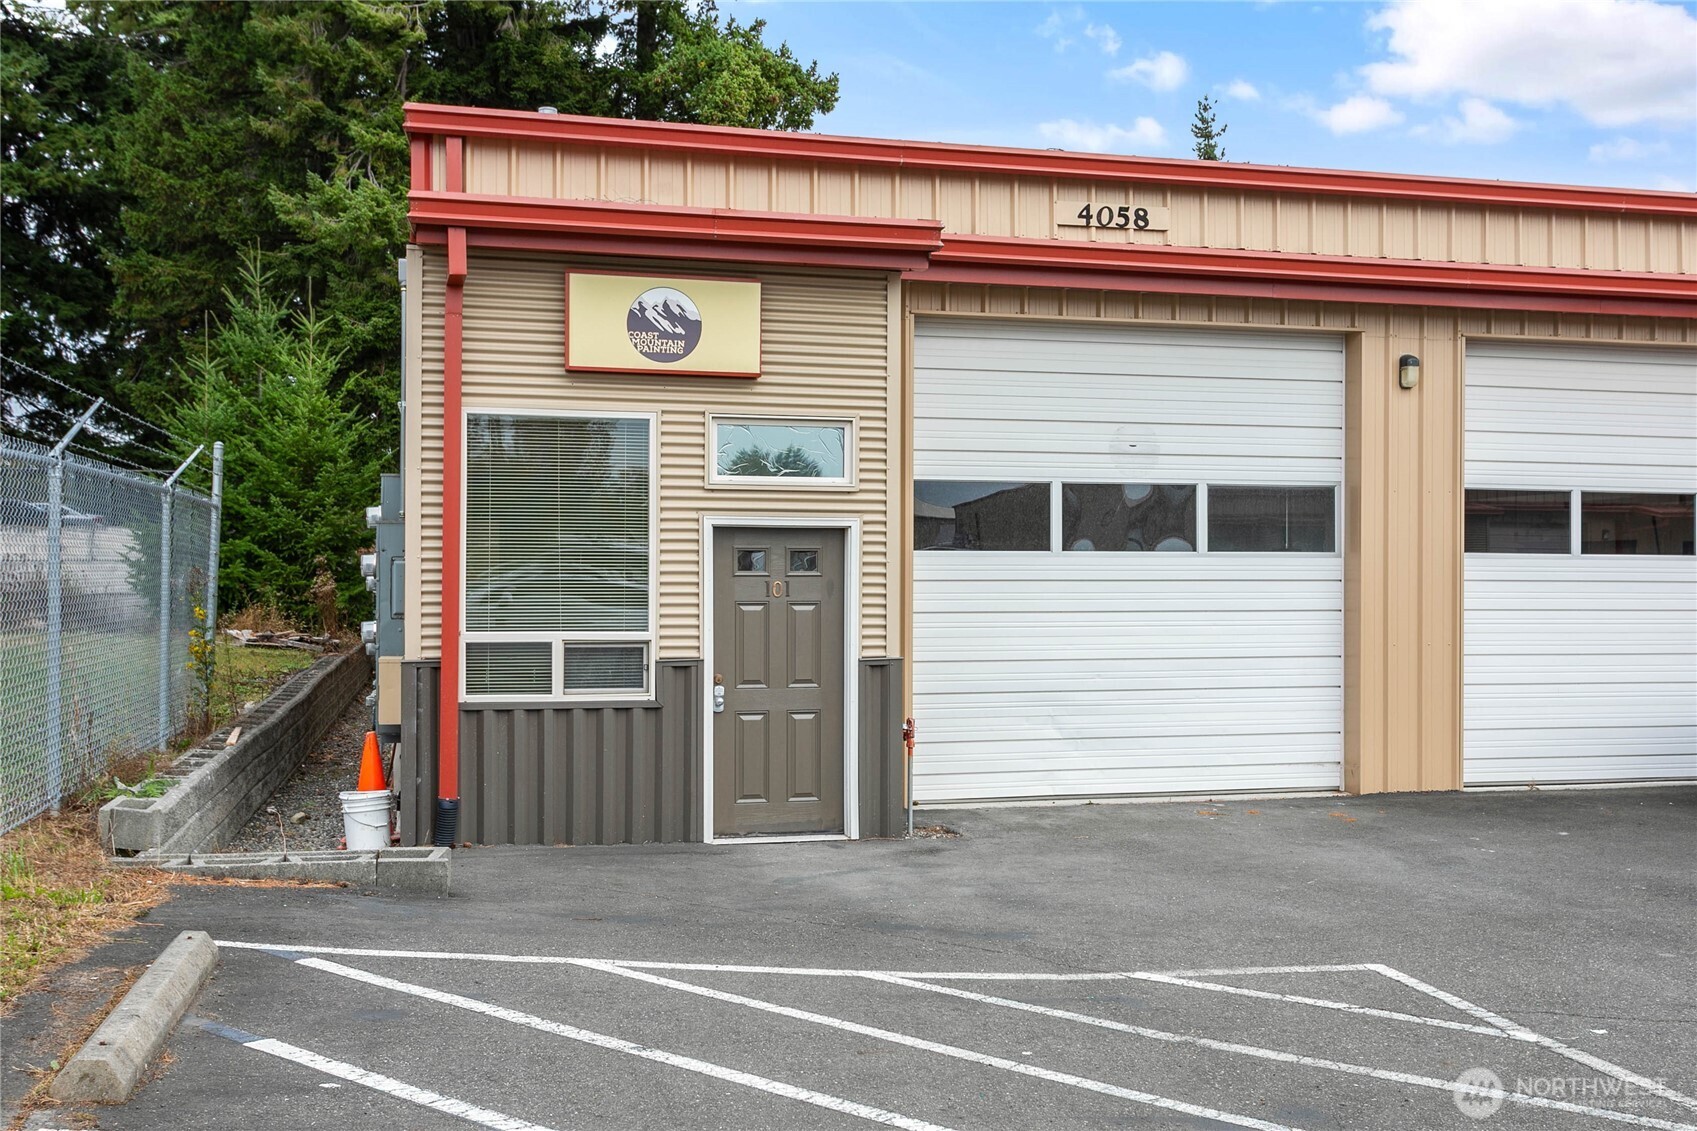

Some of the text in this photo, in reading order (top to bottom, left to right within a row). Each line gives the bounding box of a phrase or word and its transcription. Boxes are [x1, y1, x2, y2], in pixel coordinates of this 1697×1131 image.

[1077, 203, 1150, 230] 4058
[628, 330, 659, 340] COAST
[632, 338, 685, 348] MOUNTAIN
[637, 345, 684, 355] PAINTING
[764, 580, 790, 598] 101
